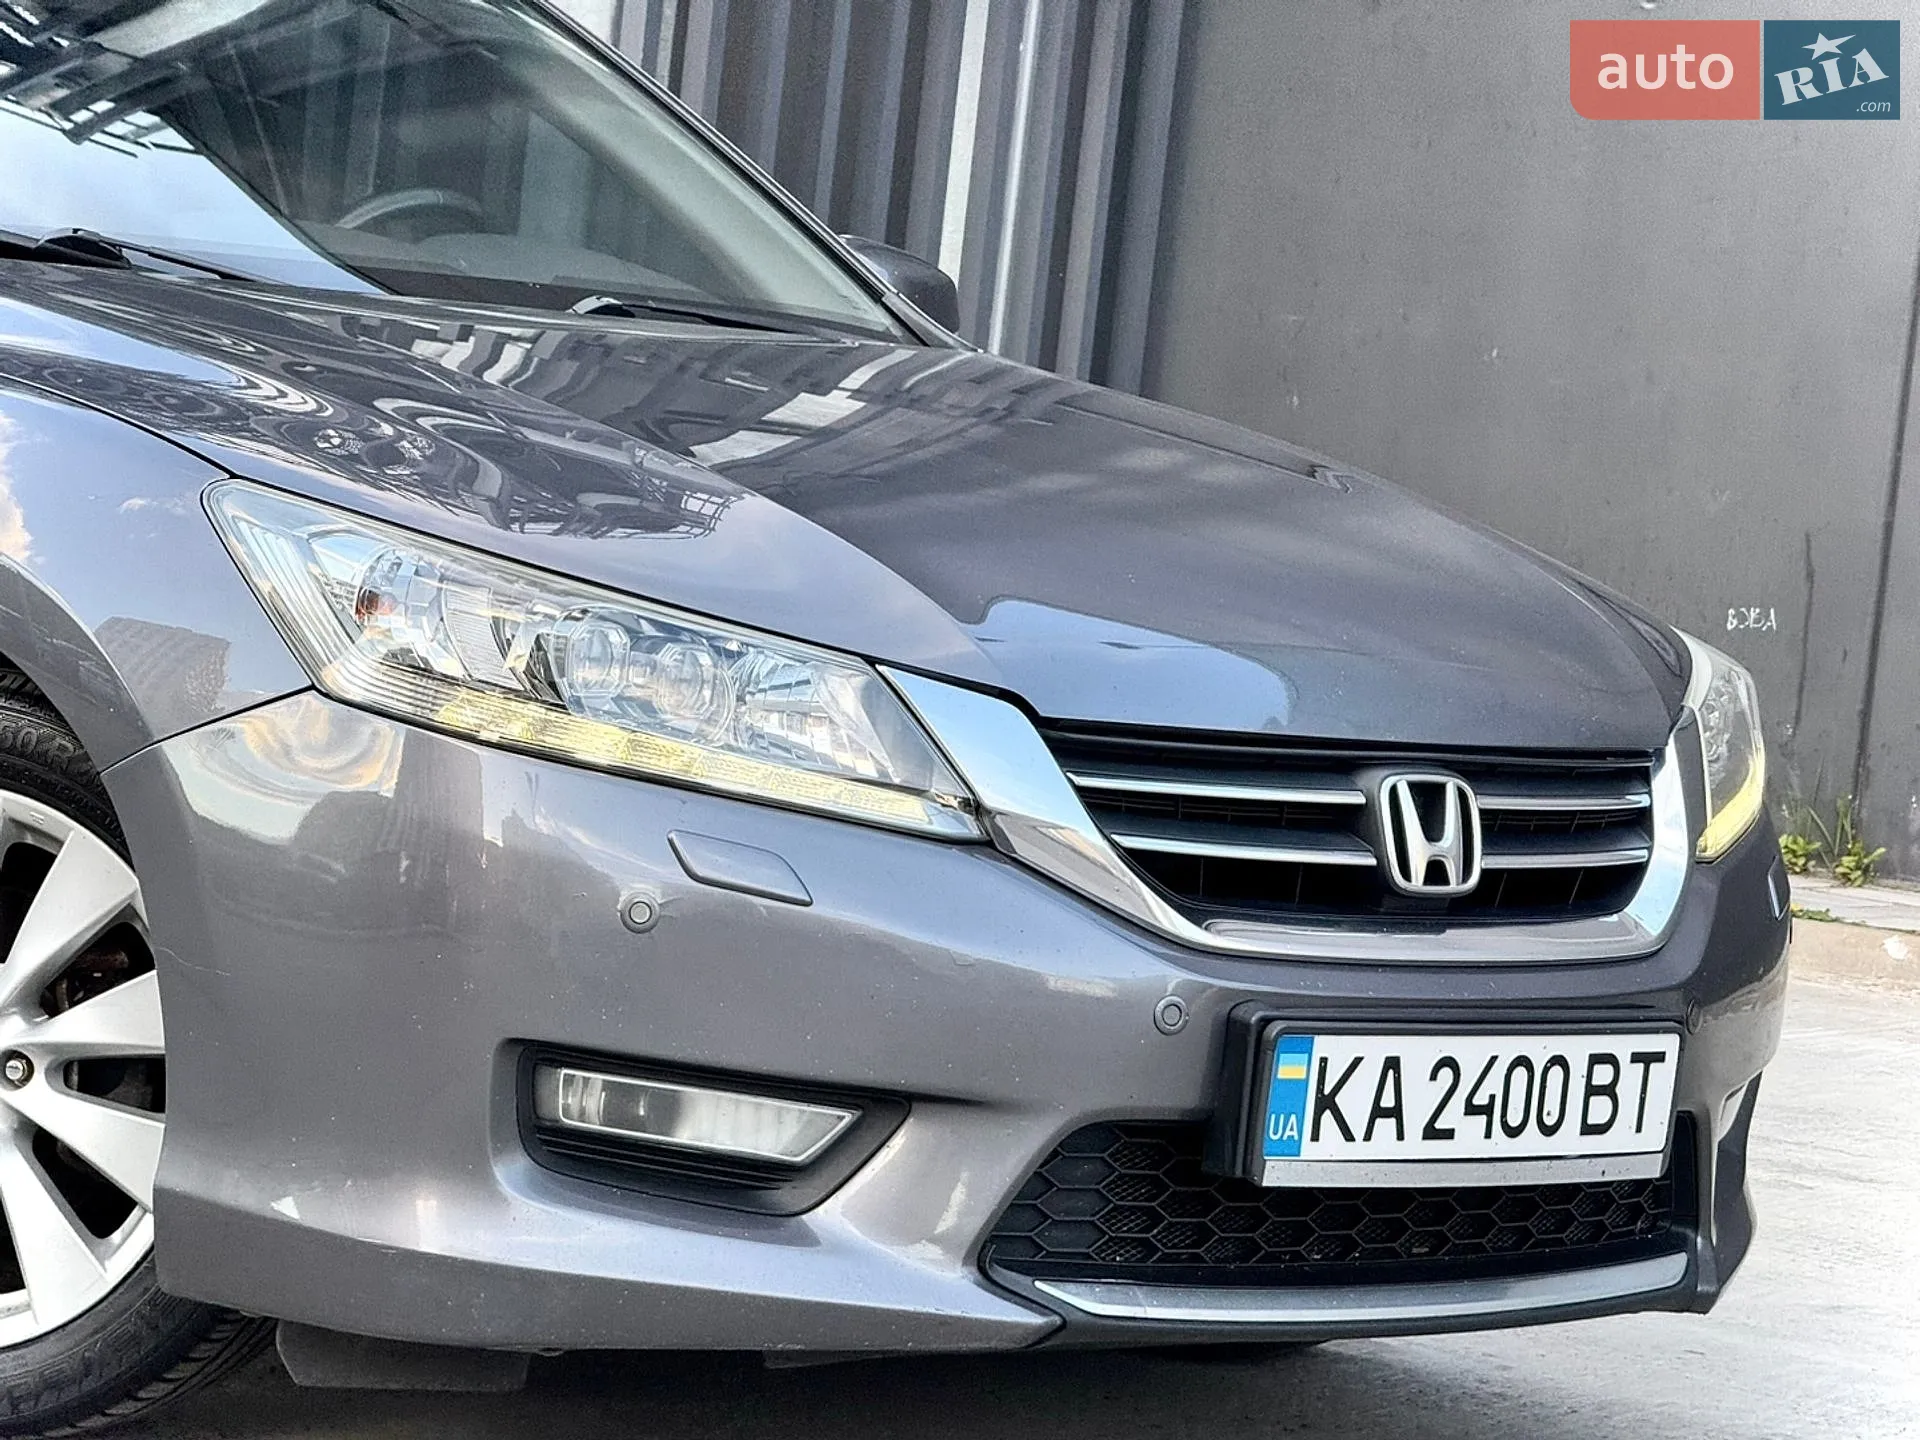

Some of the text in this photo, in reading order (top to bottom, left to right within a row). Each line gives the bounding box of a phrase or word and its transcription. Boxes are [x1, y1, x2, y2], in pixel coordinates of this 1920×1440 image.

[1310, 1051, 1666, 1142] KA 2400 BT
[1269, 1114, 1298, 1141] UA
